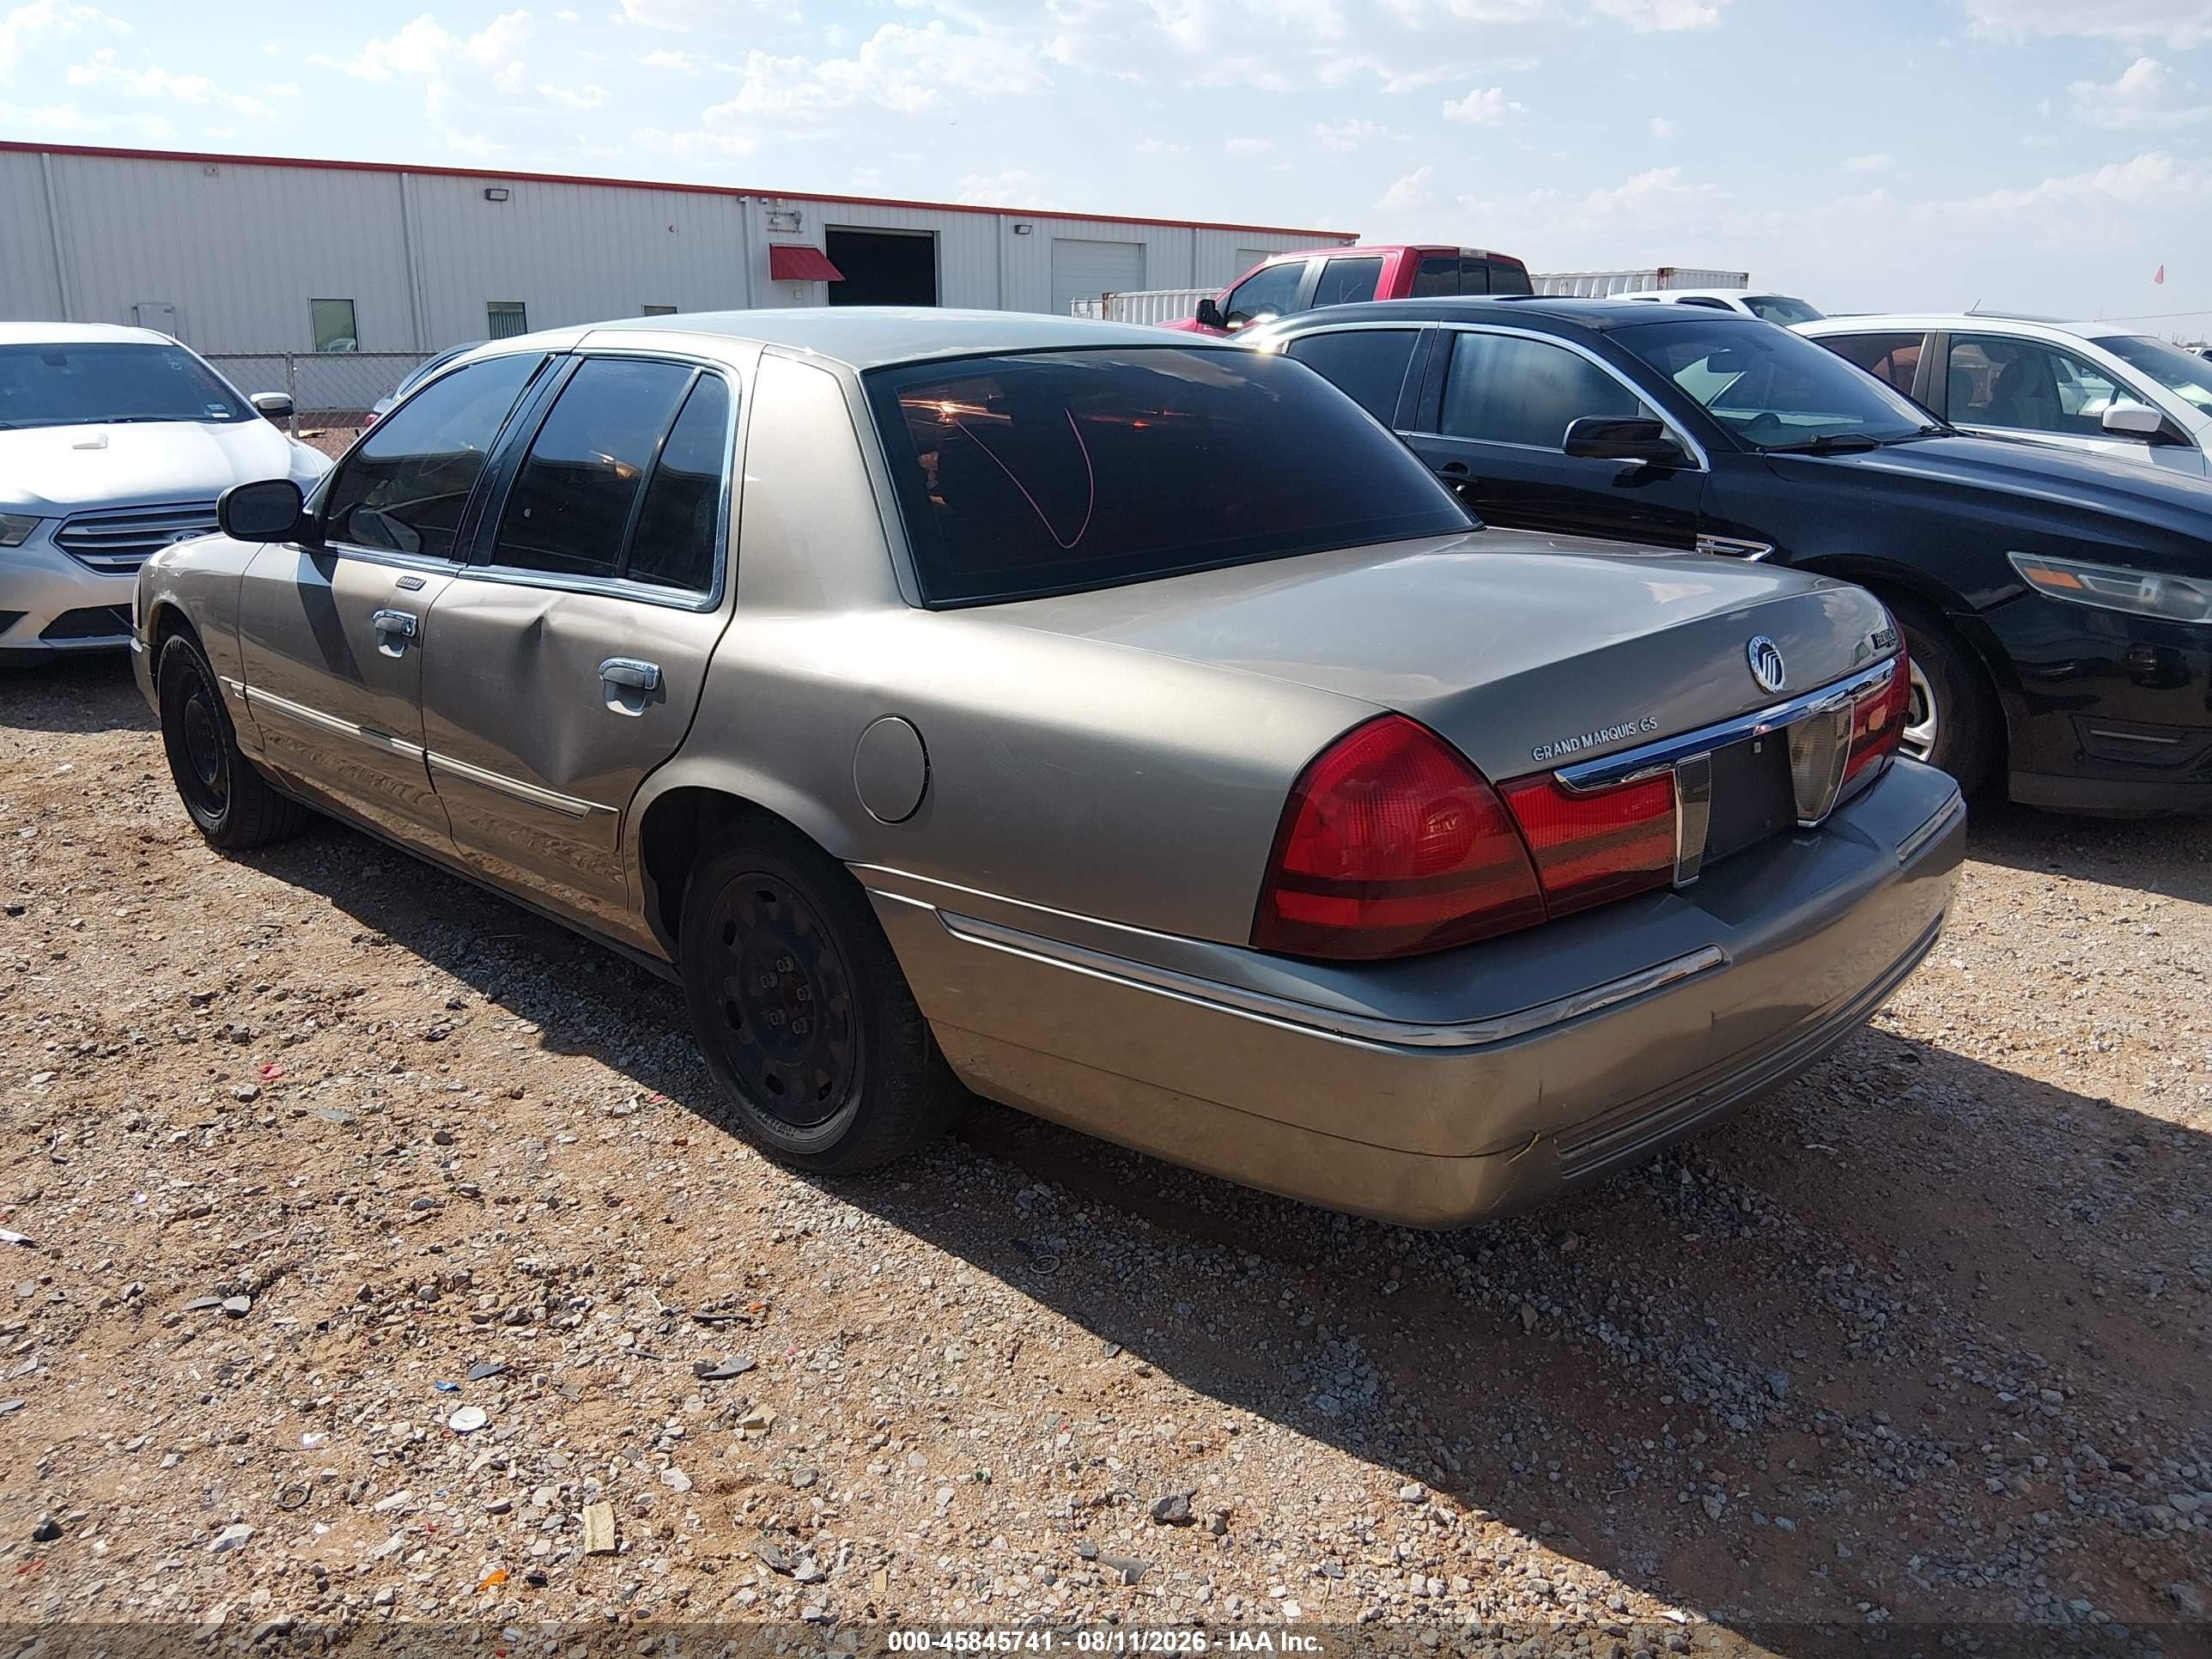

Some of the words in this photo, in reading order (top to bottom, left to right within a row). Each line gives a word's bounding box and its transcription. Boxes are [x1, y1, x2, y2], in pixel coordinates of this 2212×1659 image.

[1533, 738, 1580, 762] GRAND
[1580, 722, 1637, 749] MARQUIS
[1639, 716, 1658, 732] GS
